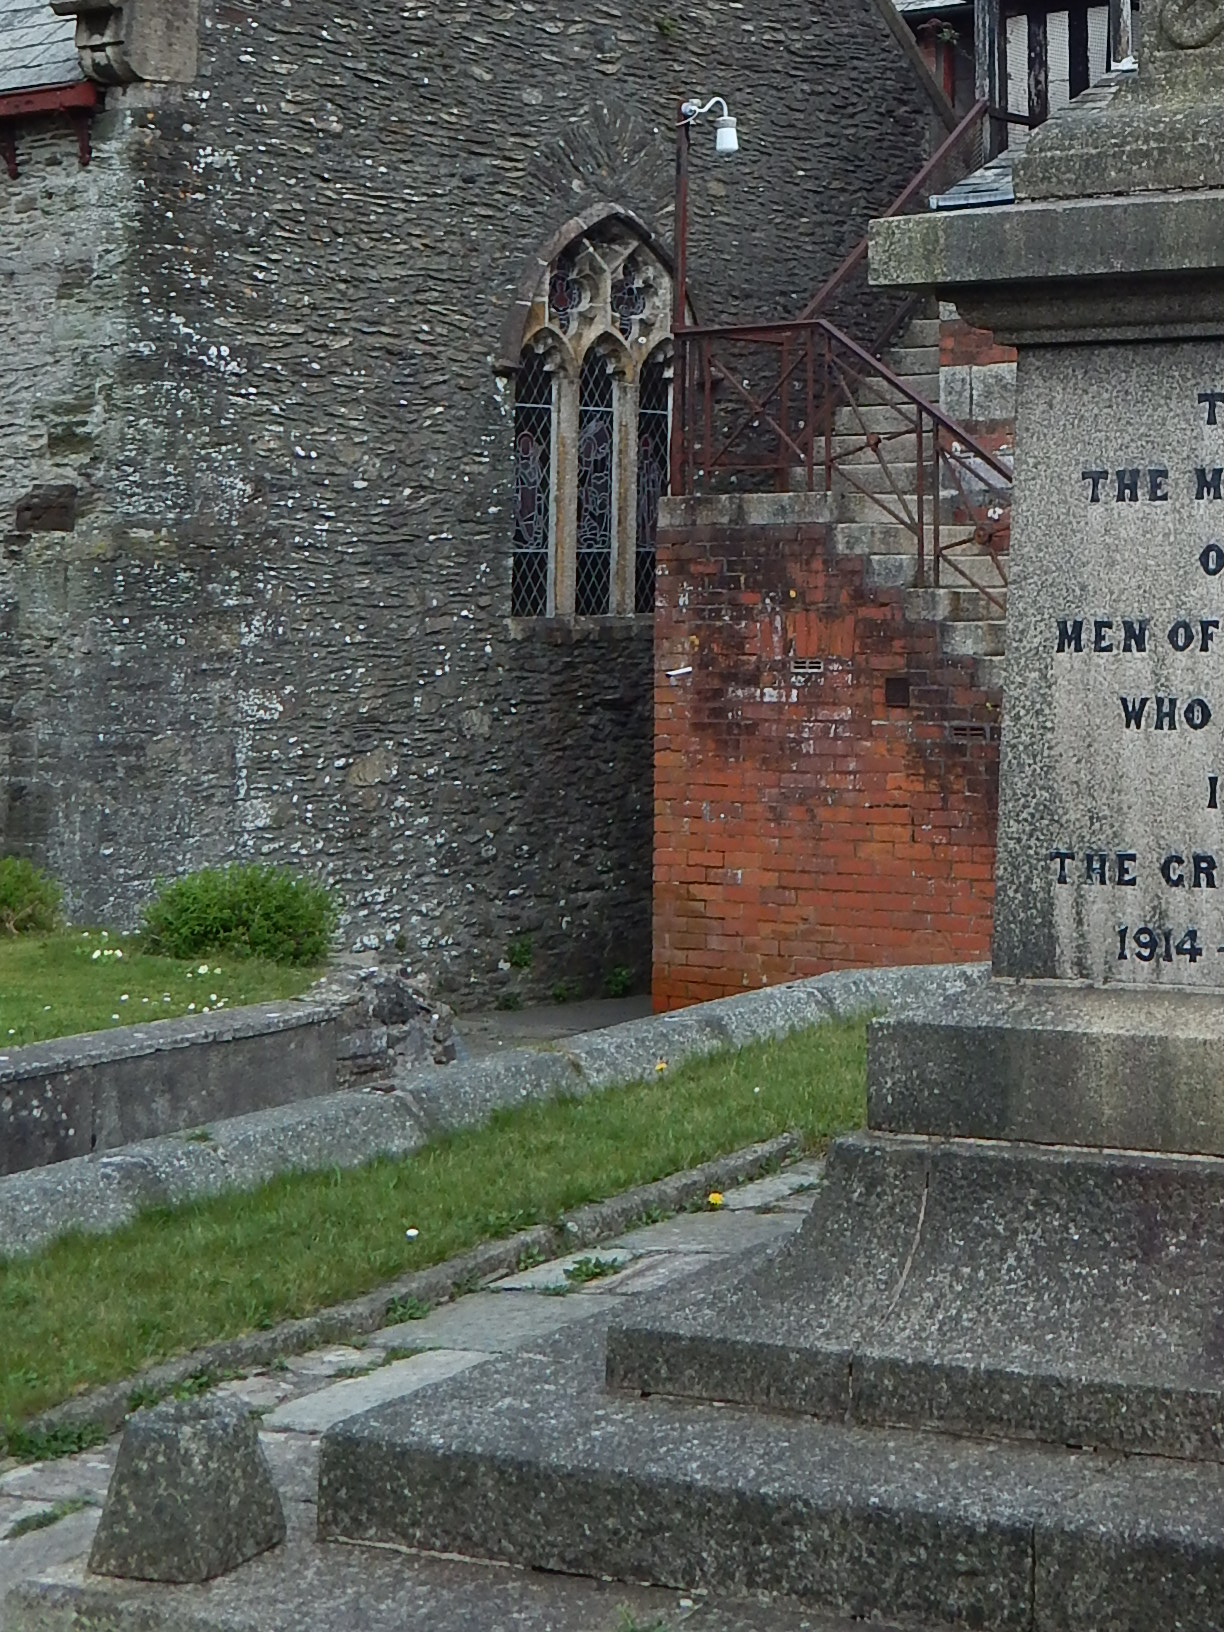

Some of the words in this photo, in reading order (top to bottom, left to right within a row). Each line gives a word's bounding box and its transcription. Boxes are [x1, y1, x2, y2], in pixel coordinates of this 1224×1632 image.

[1082, 469, 1169, 504] THE
[1057, 620, 1148, 654] MEN
[1168, 620, 1219, 653] OF
[1121, 697, 1211, 730] WHO
[1050, 850, 1137, 886] THE
[1117, 925, 1203, 964] 1914
